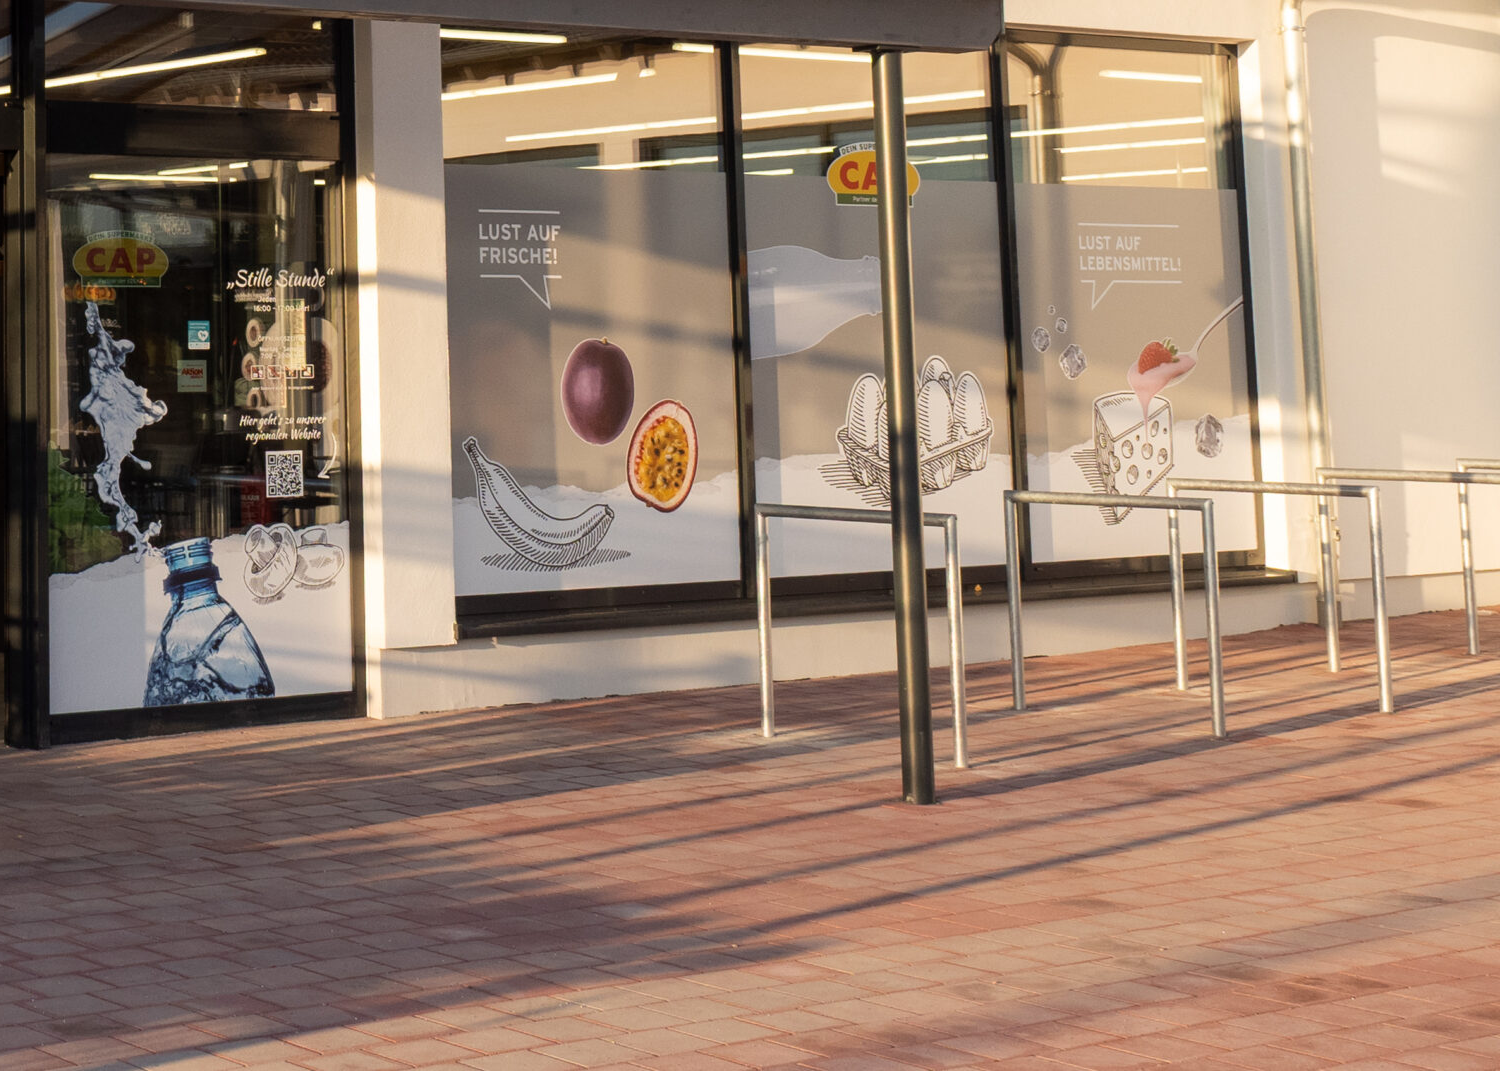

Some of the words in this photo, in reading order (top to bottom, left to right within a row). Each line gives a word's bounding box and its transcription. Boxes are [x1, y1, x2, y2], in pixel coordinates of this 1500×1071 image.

[841, 145, 858, 155] DEIN
[840, 160, 877, 191] CA
[479, 223, 522, 241] LUST
[527, 224, 561, 241] AUF
[1078, 235, 1112, 250] LUST
[1115, 235, 1142, 251] AUF
[85, 246, 157, 274] CAP
[479, 246, 558, 265] FRISCHE!
[1079, 255, 1182, 272] LEBENSMITTEL!
[239, 415, 258, 427] Hier
